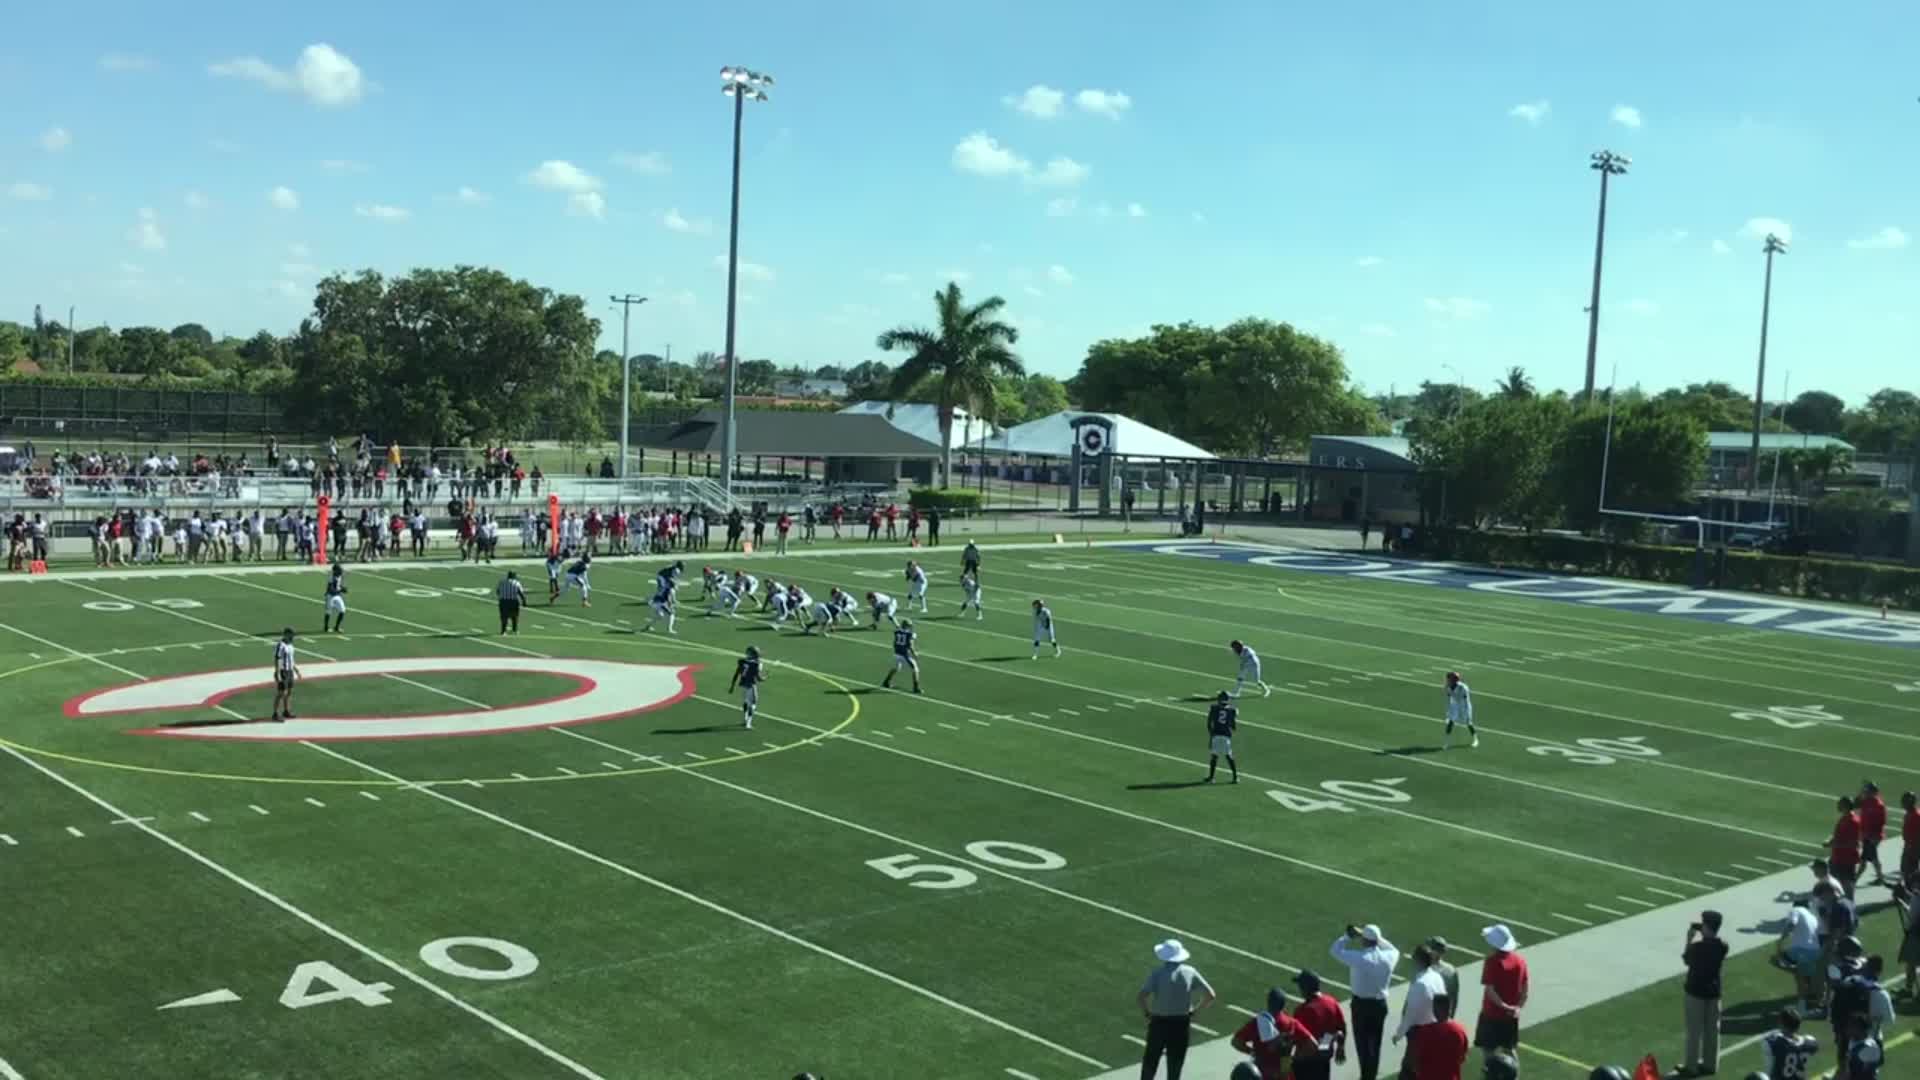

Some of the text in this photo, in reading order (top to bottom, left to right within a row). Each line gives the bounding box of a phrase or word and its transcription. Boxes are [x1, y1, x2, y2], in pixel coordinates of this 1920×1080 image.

[1218, 710, 1227, 724] 2
[1527, 737, 1661, 765] 30
[1265, 777, 1412, 814] 40
[865, 840, 1067, 889] 50
[279, 936, 540, 1009] 40
